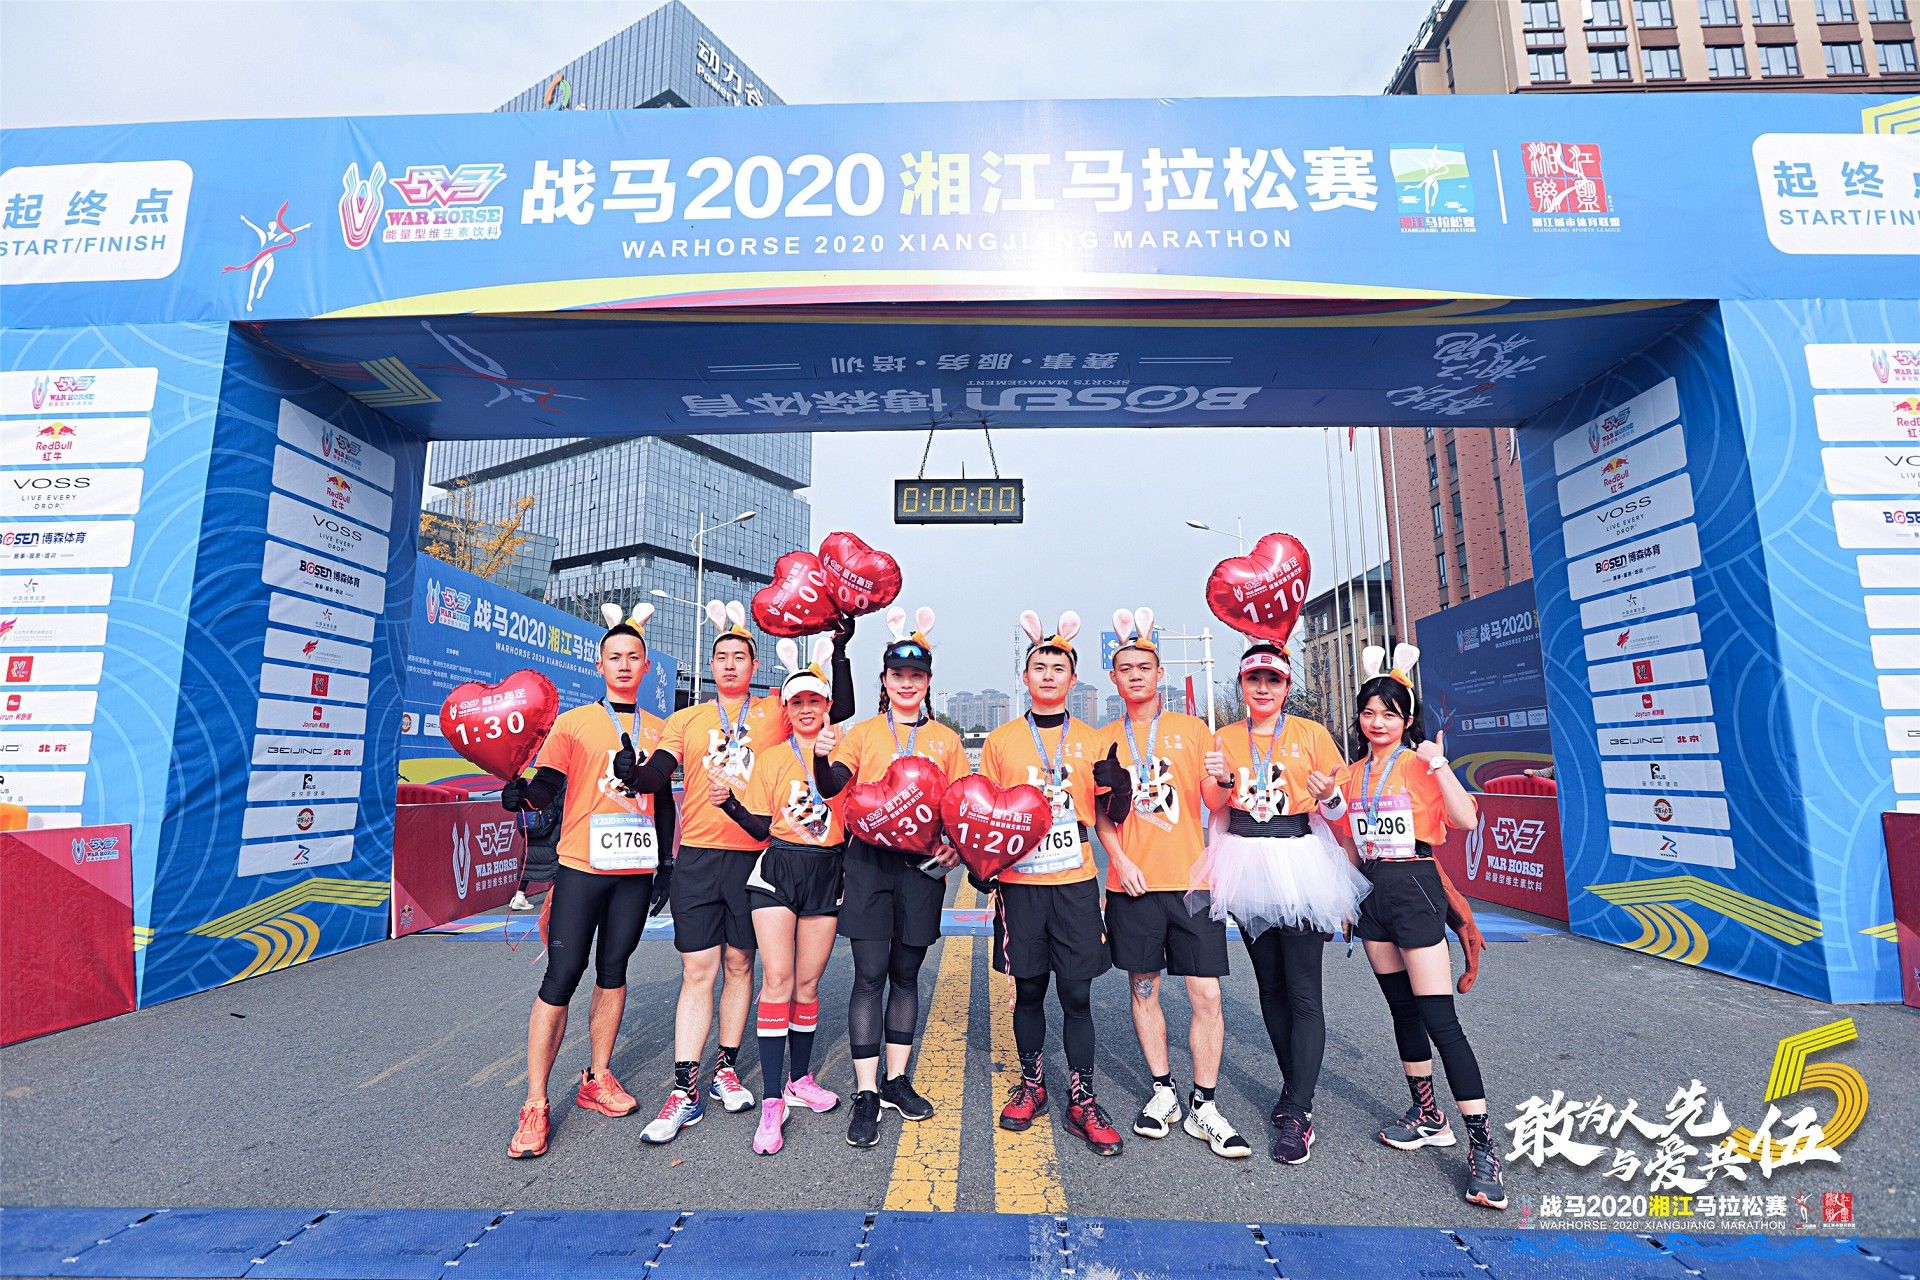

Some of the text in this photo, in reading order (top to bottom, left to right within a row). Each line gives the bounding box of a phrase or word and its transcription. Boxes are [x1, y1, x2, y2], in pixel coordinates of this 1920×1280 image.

[1772, 160, 1920, 199] 起终
[388, 208, 501, 226] WAR HORSE
[385, 226, 500, 242] 能量型维生素饮料
[622, 229, 1293, 260] WARHORSE 2020 XIANGJIANG MARATHON
[42, 452, 62, 462] 红牛
[13, 477, 91, 489] VOSS
[1610, 483, 1625, 494] 红牛
[331, 499, 345, 511] 红牛
[902, 486, 1015, 513] 0:00:00
[1597, 496, 1652, 523] VOSS
[312, 514, 363, 543] VOSS
[1606, 513, 1645, 532] LIVE EVERY
[42, 531, 87, 545] 博森体育
[319, 532, 355, 550] LIVE EVERY
[1242, 578, 1305, 624] 1:10
[495, 641, 531, 662] WARHORSE
[455, 710, 526, 746] 1:30
[38, 744, 68, 753] 北京
[874, 803, 933, 848] 1:30
[1356, 816, 1406, 836] D296
[601, 832, 652, 849] C1766
[957, 822, 1025, 856] 1:20
[474, 858, 518, 878] WAR HORSE
[1486, 855, 1544, 878] WAR HORSE
[1484, 871, 1543, 892] 能量型维生素饮料
[791, 1249, 836, 1258] Feibot
